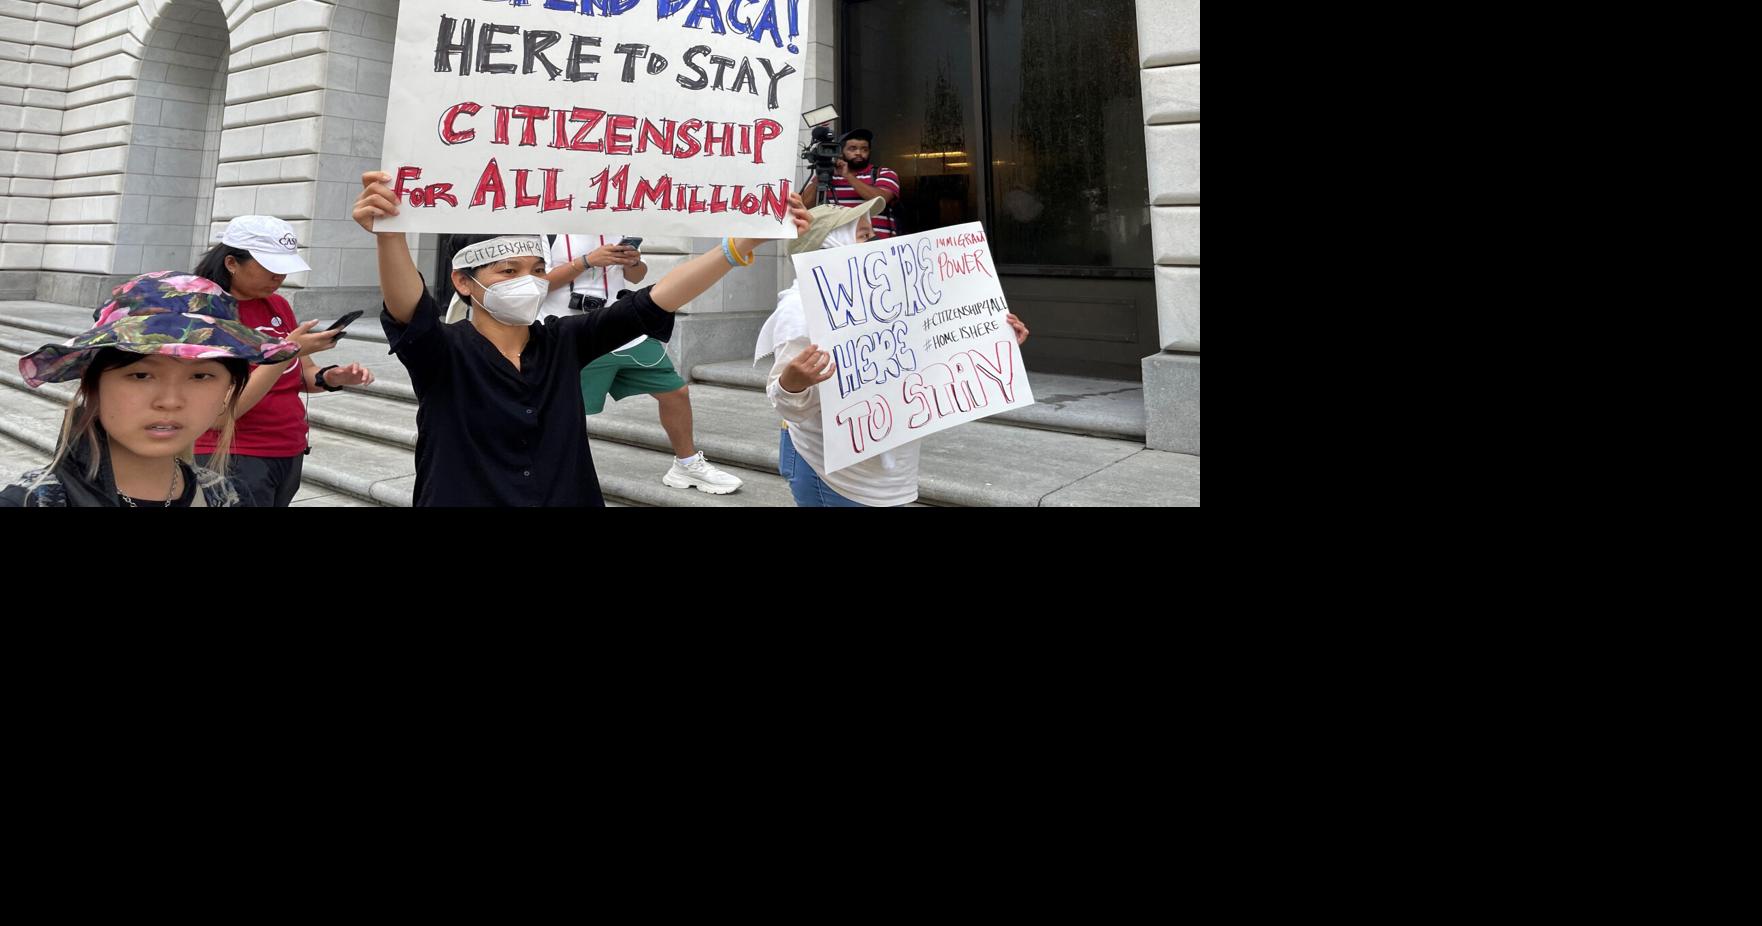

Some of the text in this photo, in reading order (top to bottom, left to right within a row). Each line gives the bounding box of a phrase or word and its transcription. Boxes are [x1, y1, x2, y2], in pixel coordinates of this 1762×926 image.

[434, 14, 602, 83] HERE
[676, 45, 796, 110] STAY
[438, 101, 783, 164] CITIZENSHIP
[469, 157, 573, 211] ALL
[812, 237, 942, 331] WE'RE
[938, 249, 992, 281] POWER
[833, 320, 917, 398] HERE
[836, 341, 1015, 453] TO STAY
